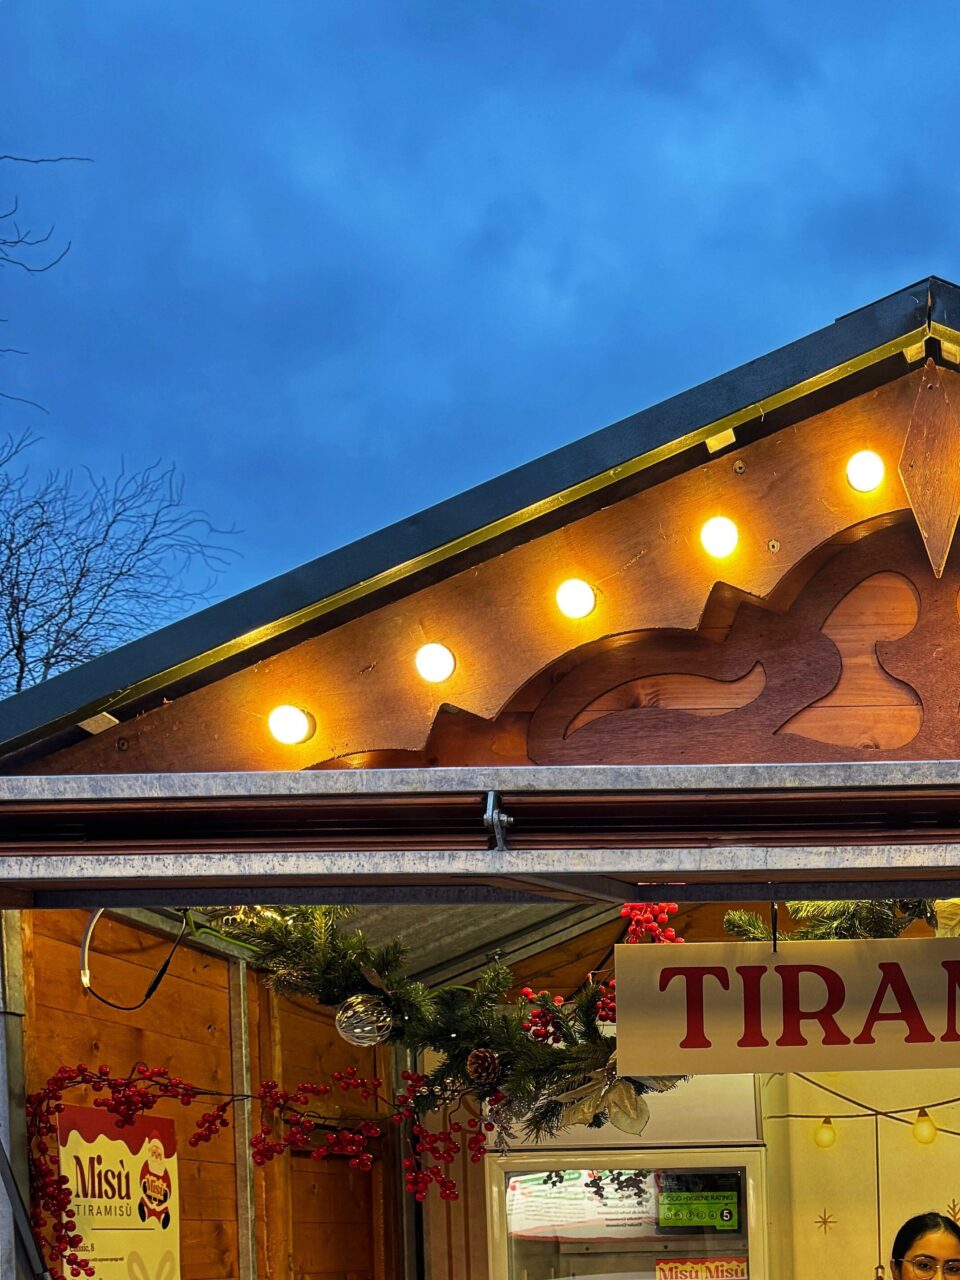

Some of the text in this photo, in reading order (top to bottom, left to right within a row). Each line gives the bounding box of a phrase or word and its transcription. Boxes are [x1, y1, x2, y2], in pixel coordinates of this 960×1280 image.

[73, 1154, 131, 1200] Misù
[75, 1203, 132, 1217] TIRAMISÙ
[723, 1210, 731, 1221] 5
[658, 1266, 699, 1280] Misù
[705, 1263, 745, 1279] Misù
